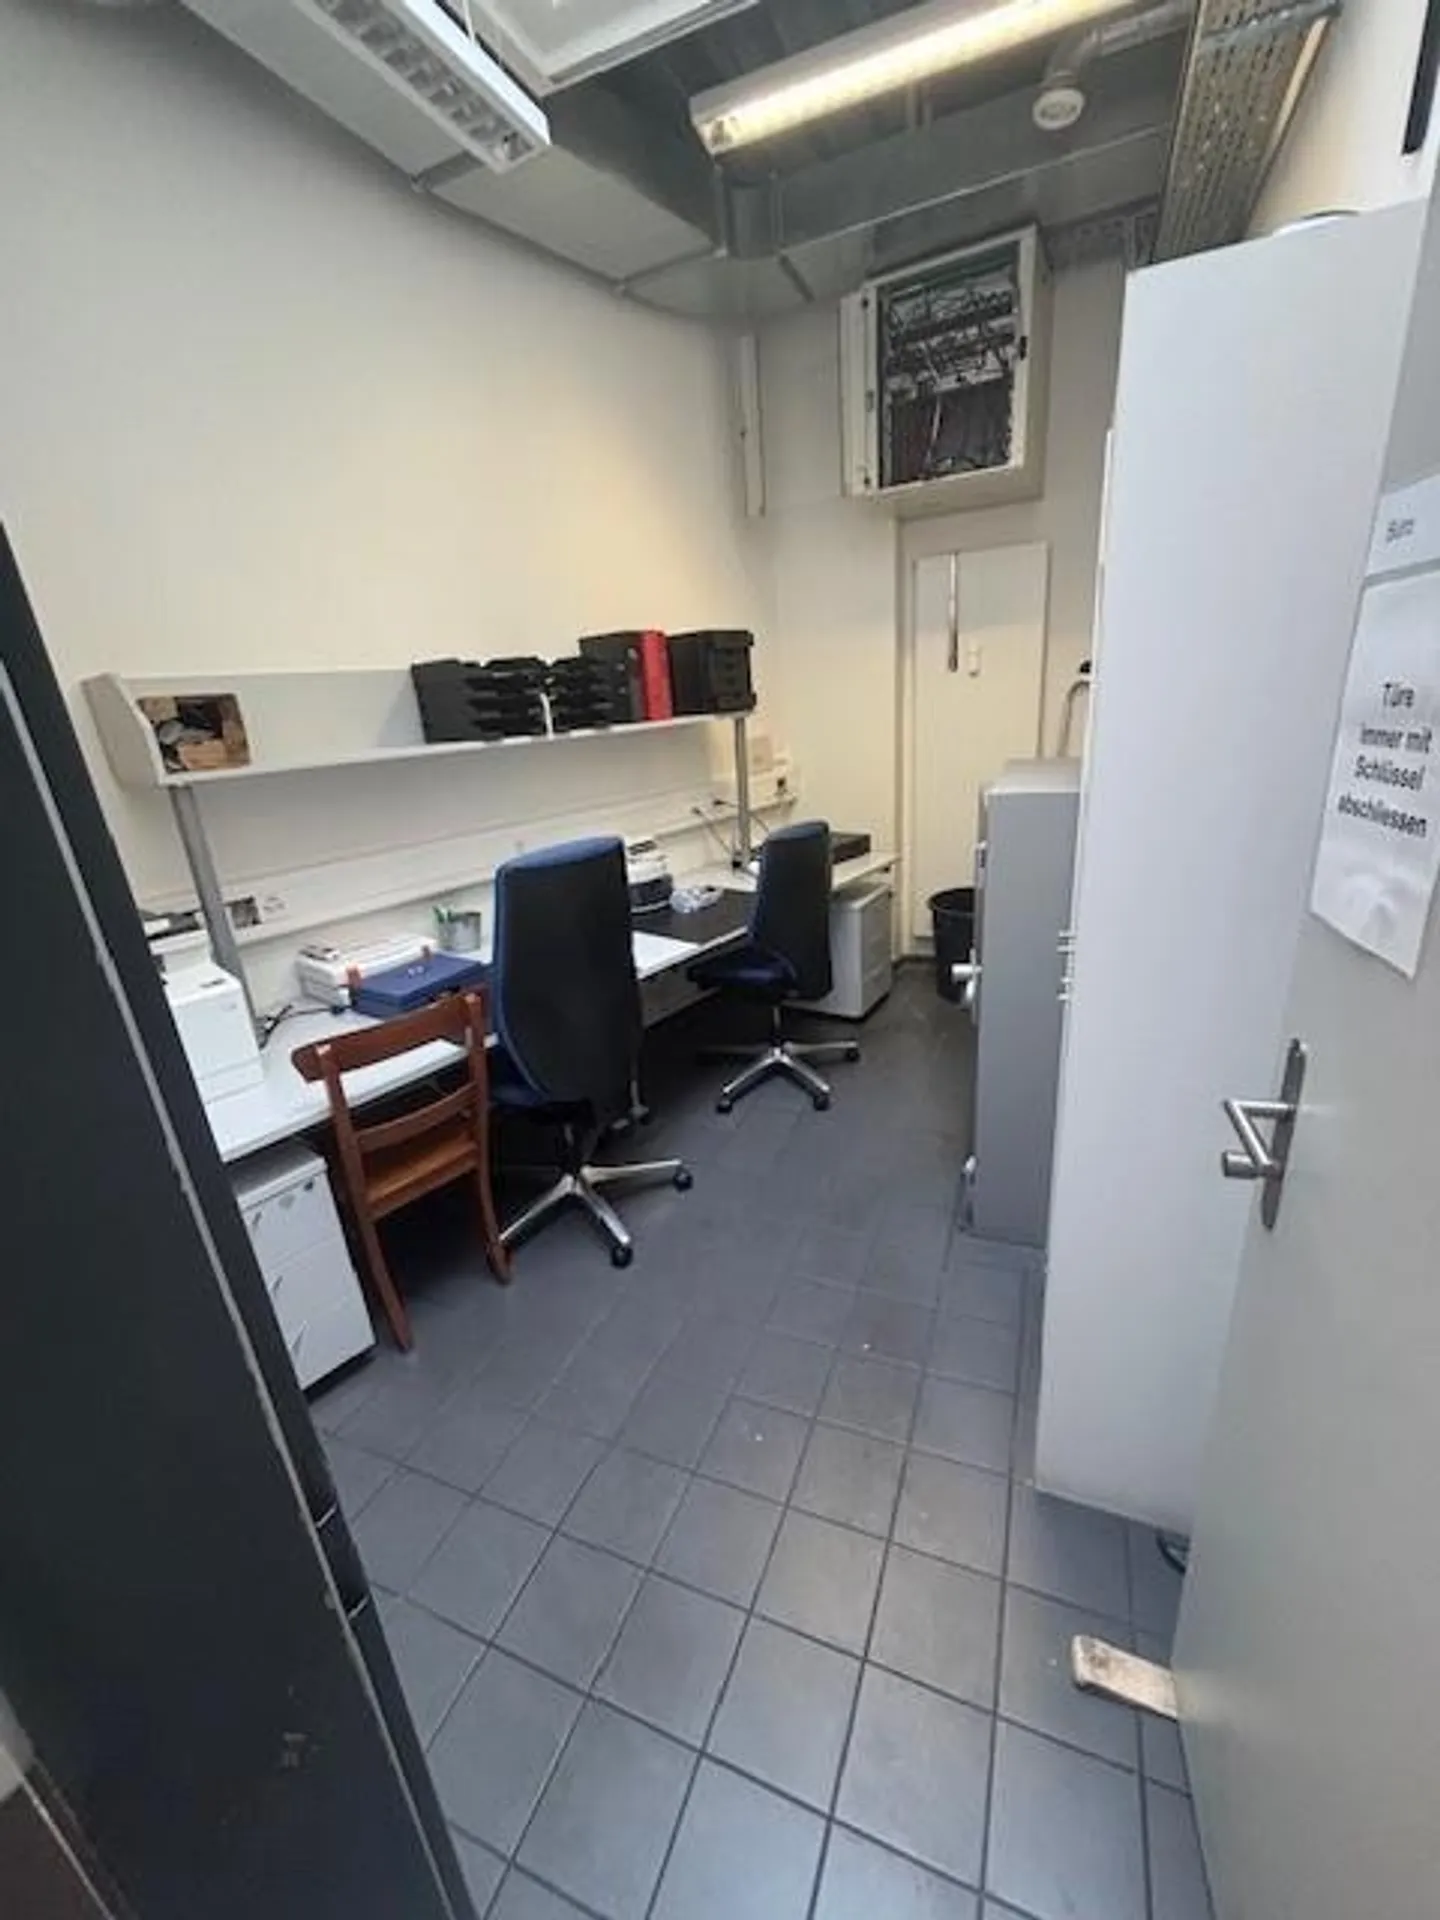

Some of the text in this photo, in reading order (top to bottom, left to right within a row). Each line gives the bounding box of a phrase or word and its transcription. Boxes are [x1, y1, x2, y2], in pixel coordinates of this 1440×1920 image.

[1383, 682, 1414, 708] Türe
[1405, 726, 1432, 753] mit
[1354, 753, 1426, 792] Schlüssel
